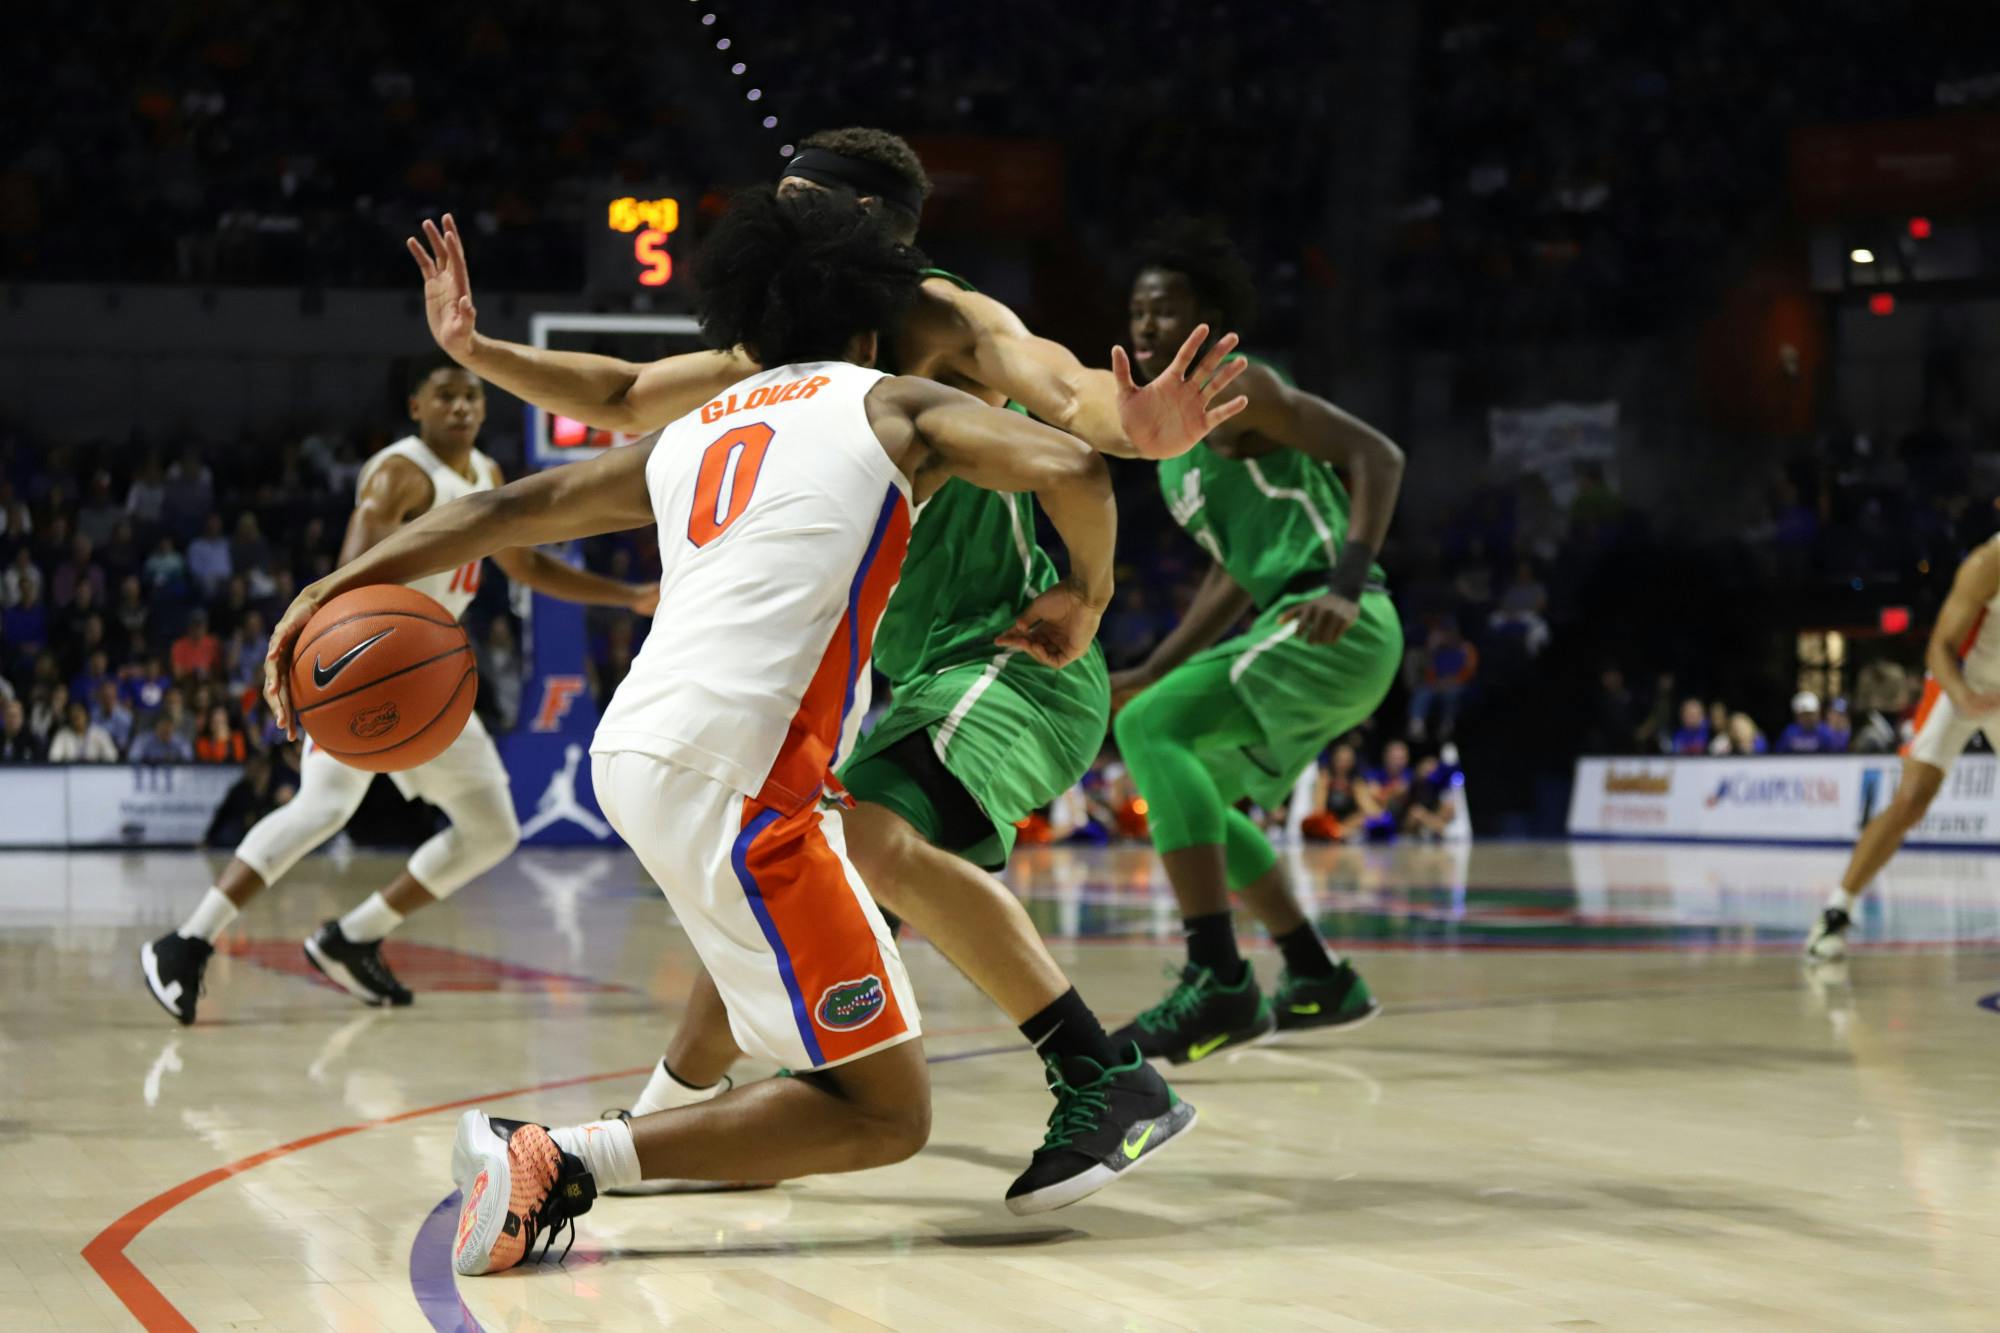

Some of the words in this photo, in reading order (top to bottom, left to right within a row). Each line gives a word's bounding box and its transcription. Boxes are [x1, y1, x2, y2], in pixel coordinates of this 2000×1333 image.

[701, 375, 831, 424] GLOVER
[687, 421, 776, 549] 0
[530, 674, 586, 733] F
